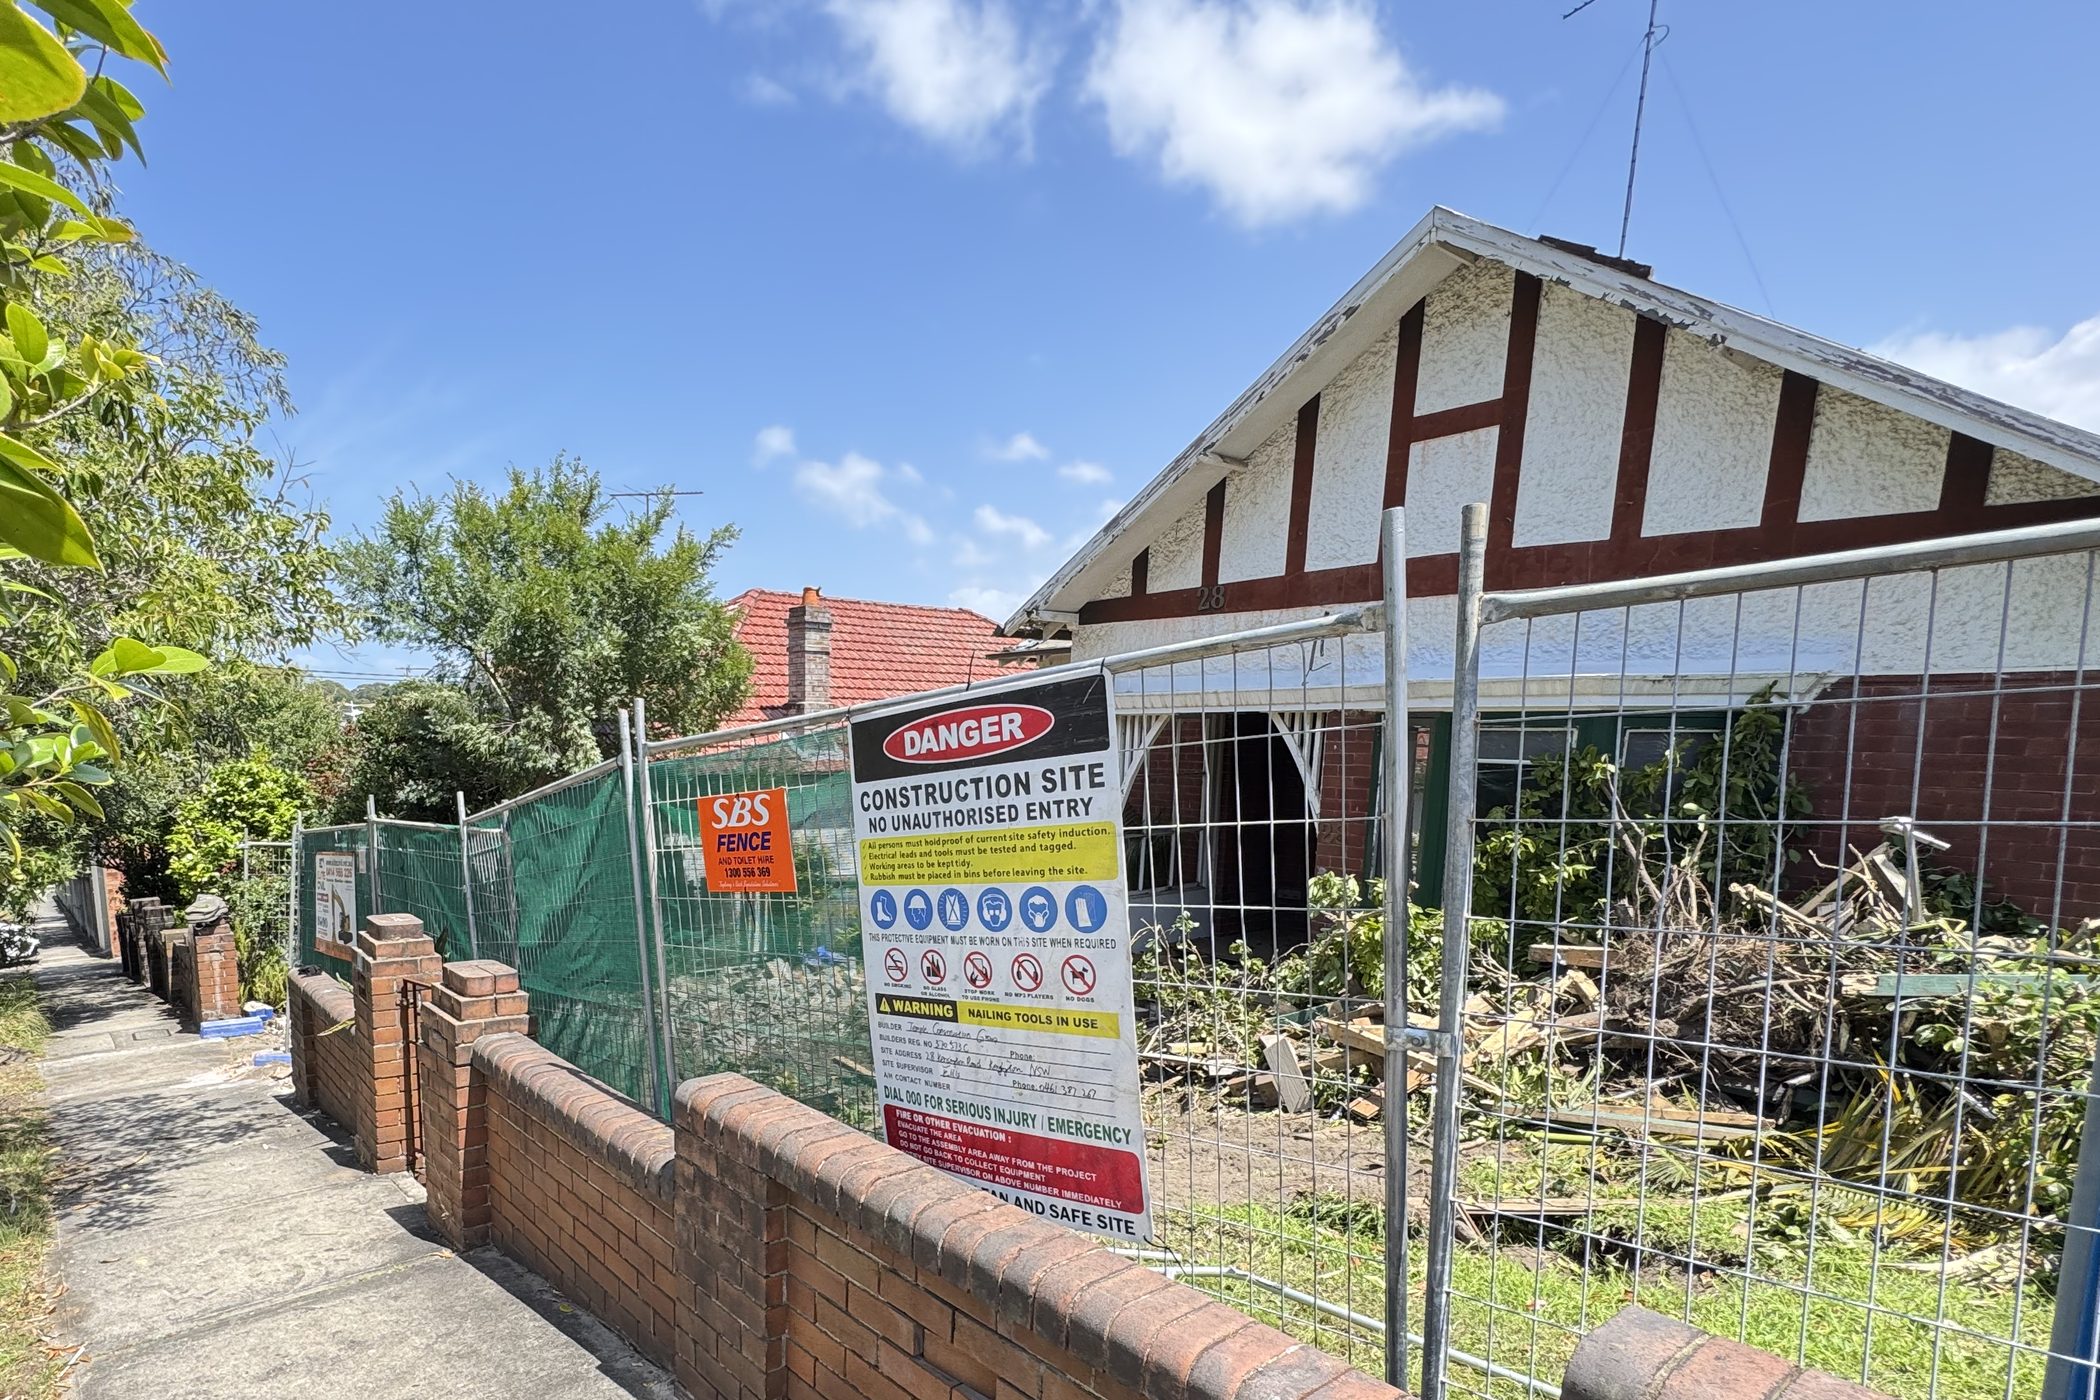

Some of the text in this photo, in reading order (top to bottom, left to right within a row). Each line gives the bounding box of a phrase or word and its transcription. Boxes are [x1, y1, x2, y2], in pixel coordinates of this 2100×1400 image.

[1198, 585, 1225, 611] 28
[903, 712, 1024, 756] DANGER
[860, 762, 1105, 812] CONSTRUCTION SITE
[712, 794, 770, 829] SBS
[868, 796, 1094, 834] NO UNAUTHORISED ENTRY
[717, 832, 772, 853] FENCE
[878, 842, 902, 850] persons
[906, 840, 922, 848] must
[924, 838, 940, 846] hold
[942, 836, 963, 847] proof
[966, 835, 974, 844] of
[976, 834, 1007, 843] current
[1008, 832, 1024, 841] site
[1028, 830, 1056, 840] safety
[1059, 826, 1110, 838] induction.
[718, 855, 774, 865] AND TOILET HIRE
[868, 841, 1076, 860] Electrical leads and tools must be tested and tagged.
[725, 867, 771, 878] 1300 556 369
[869, 862, 895, 871] Working
[926, 860, 935, 868] be
[937, 859, 954, 869] kept
[955, 859, 973, 870] tidy.
[870, 872, 895, 880] Rubbish
[898, 872, 915, 880] must
[928, 871, 951, 881] placed
[954, 870, 961, 878] in
[964, 870, 980, 878] bins
[983, 868, 1010, 877] before
[1012, 867, 1045, 878] leaving
[1048, 866, 1063, 875] the
[1067, 865, 1088, 875] site.
[868, 933, 1116, 949] THIS PROTECTIVE EQUIPMENT MUST BE WORN ON THIS SITE WHEN REQUIRED
[892, 999, 954, 1018] WARNING
[968, 1008, 1098, 1029] NAILING TOOLS IN USE
[878, 1021, 902, 1031] BUILDER
[879, 1034, 906, 1044] BUILDERS
[924, 1040, 932, 1048] NO
[881, 1046, 922, 1060] SITE ADDRESS
[1010, 1050, 1035, 1061] Phone:
[896, 1061, 934, 1074] SUPERVISOR
[895, 1073, 921, 1085] CONTACT
[924, 1079, 950, 1090] NUMBER
[884, 1085, 904, 1102] DIAL
[906, 1090, 922, 1106] 000
[924, 1094, 944, 1111] FOR
[945, 1098, 992, 1120] SERIOUS
[994, 1107, 1036, 1129] INJURY
[1048, 1117, 1131, 1145] EMERGENCY
[896, 1109, 1005, 1142] FIRE OR OTHER EVACUATION
[897, 1121, 962, 1143] EVACUATE THE AREA
[898, 1130, 907, 1138] GO
[918, 1135, 930, 1144] THE
[932, 1138, 966, 1153] ASSEMBLY
[968, 1147, 987, 1158] AREA
[989, 1152, 1010, 1163] AWAY
[1012, 1159, 1035, 1170] FROM
[1036, 1163, 1054, 1174] THE
[1056, 1166, 1097, 1182] PROJECT
[900, 1140, 908, 1148] DO
[910, 1142, 922, 1151] NOT
[923, 1146, 933, 1155] GO
[934, 1149, 952, 1161] BACK
[953, 1154, 963, 1163] TO
[964, 1157, 998, 1171] COLLECT
[1000, 1165, 1045, 1182] EQUIPMENT
[923, 1156, 937, 1165] SITE
[938, 1160, 980, 1177] SUPERVISOR
[982, 1172, 993, 1181] ON
[995, 1175, 1021, 1187] ABOVE
[1024, 1182, 1060, 1196] NUMBER
[1061, 1189, 1122, 1209] IMMEDIATELY
[1014, 1196, 1136, 1236] AND SAFE SITE
